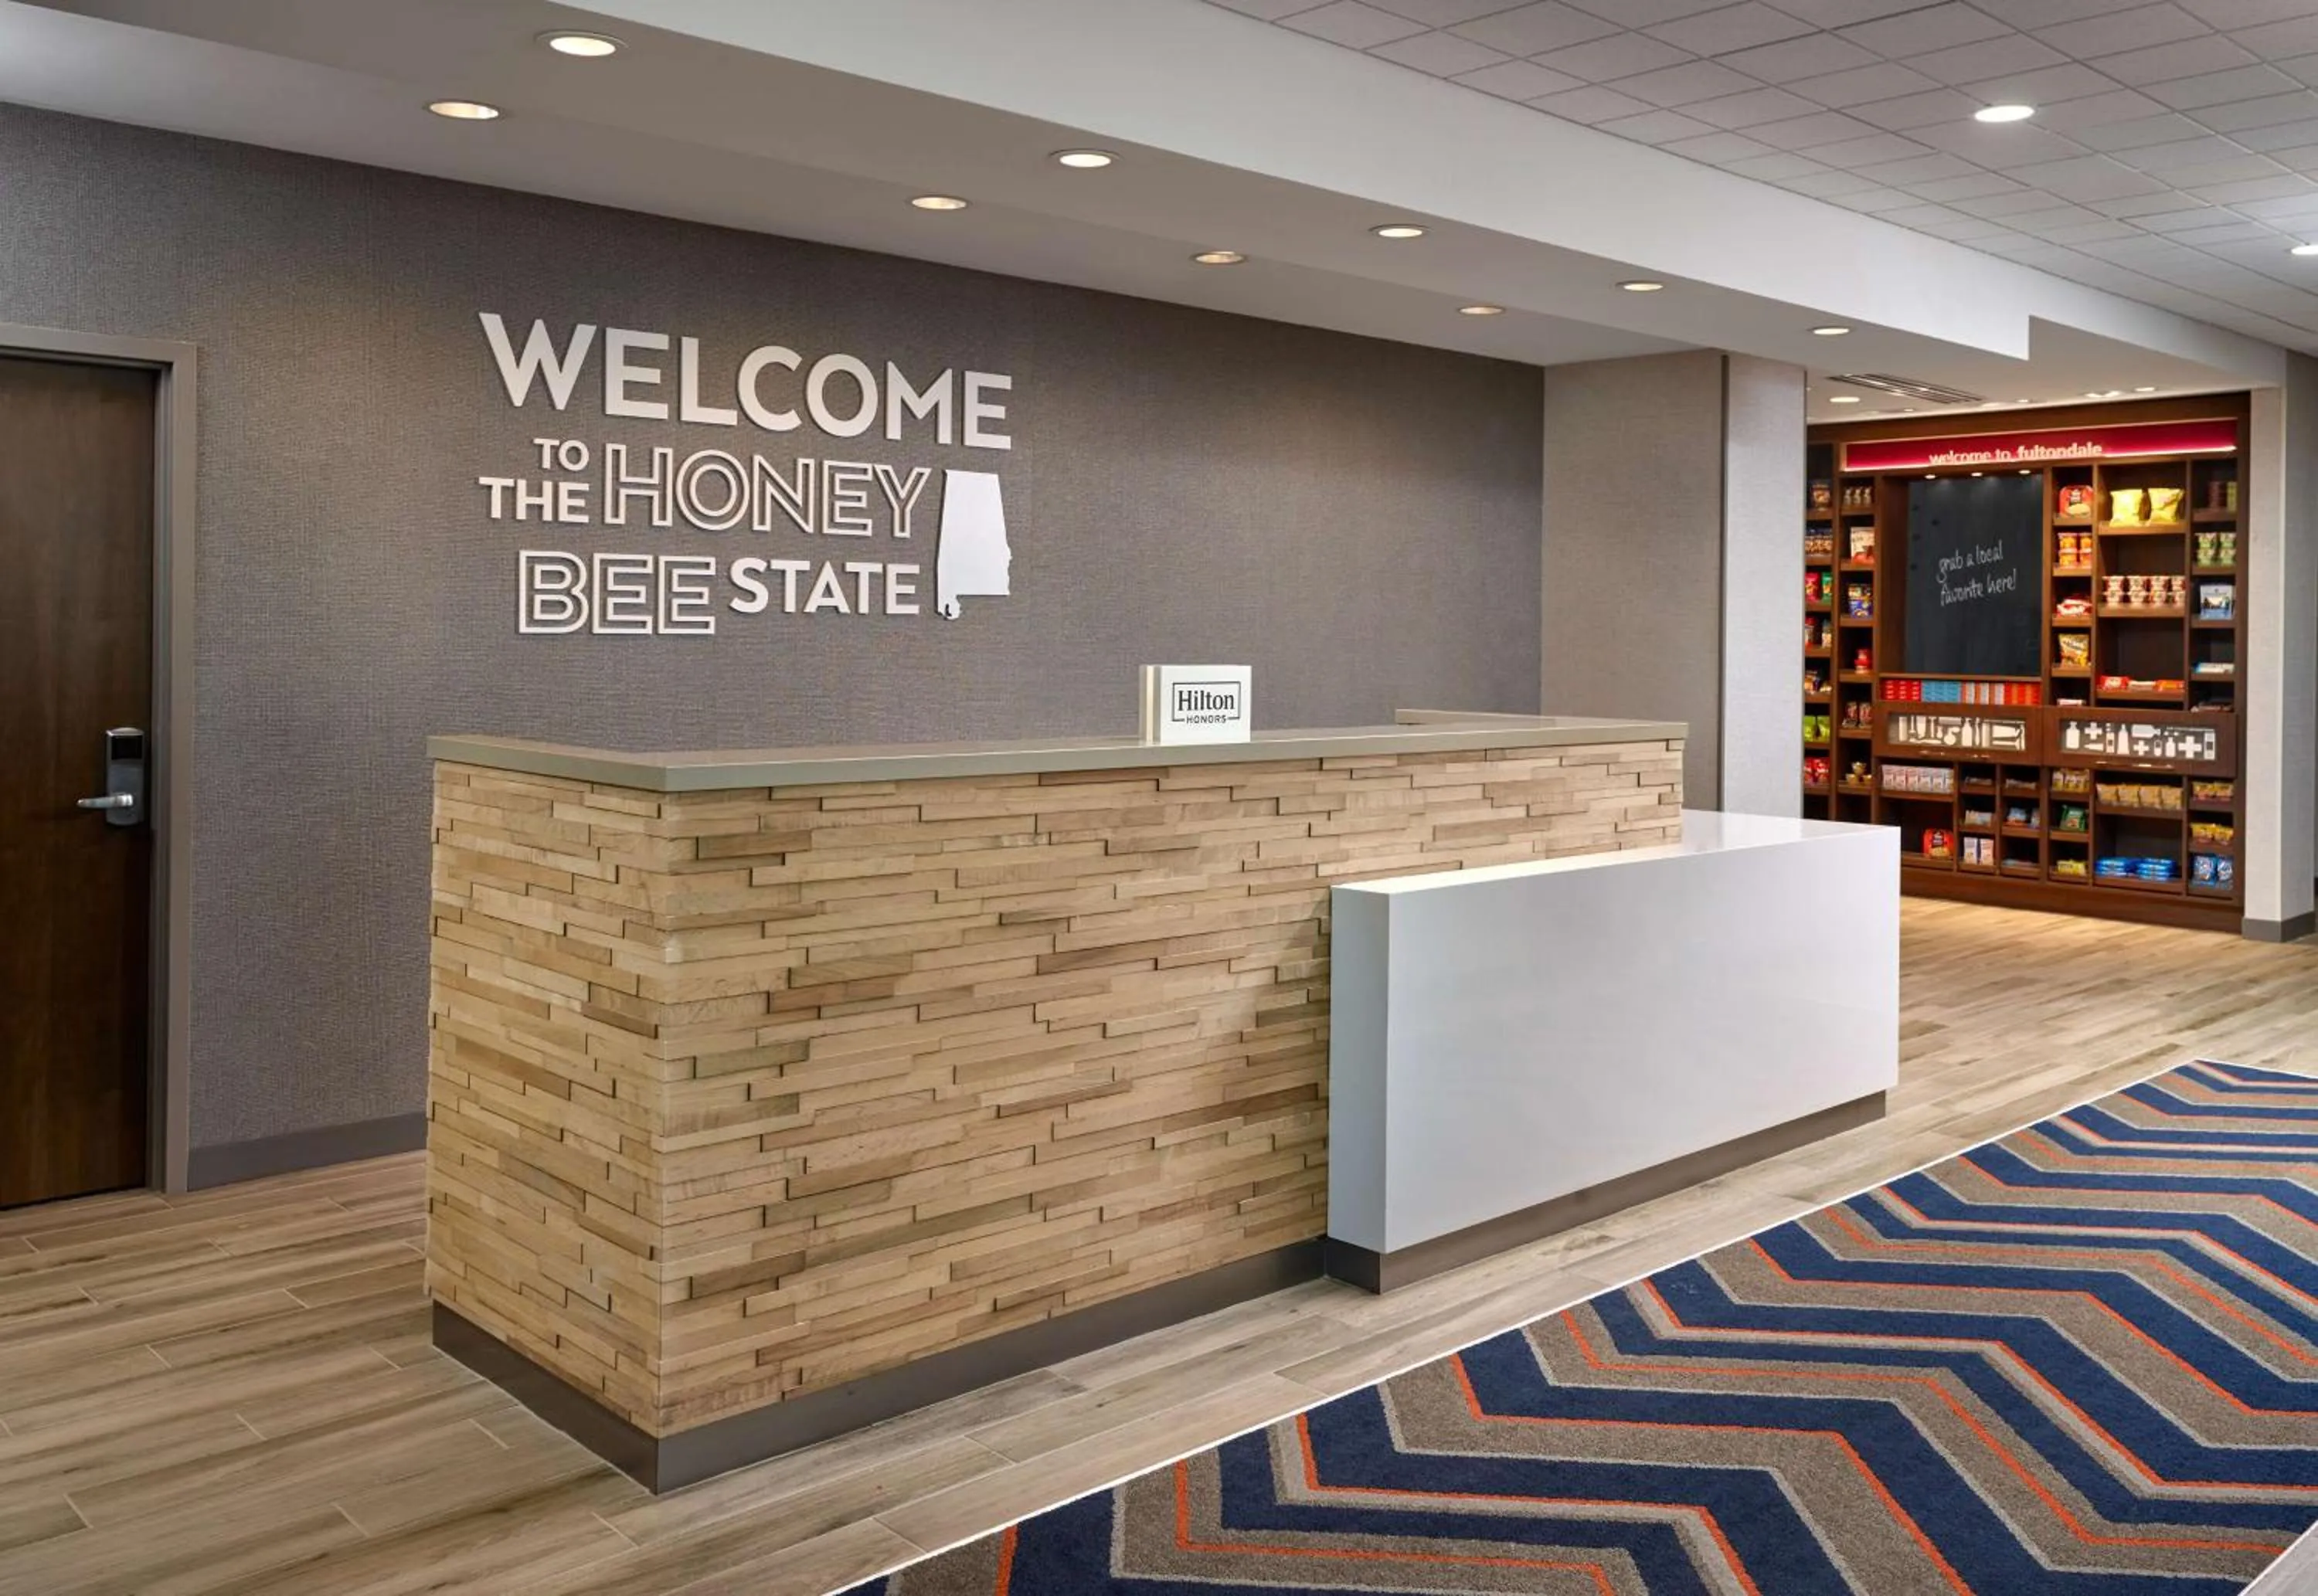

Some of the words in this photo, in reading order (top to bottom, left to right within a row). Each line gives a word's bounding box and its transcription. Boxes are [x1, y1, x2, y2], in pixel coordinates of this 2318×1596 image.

[478, 312, 1011, 450] WELCOME
[533, 438, 590, 470] TO
[1929, 450, 1991, 464] welcome
[1995, 449, 2010, 462] to
[2017, 442, 2102, 461] fultondale
[478, 477, 590, 523] THE
[604, 443, 931, 538] HONEY
[1936, 548, 1963, 584] grab
[1966, 553, 1975, 567] a
[1976, 539, 2004, 565] local
[518, 550, 715, 634] BEE
[729, 557, 921, 614] STATE
[1940, 578, 1984, 606] favorite
[1987, 569, 2017, 594] here!
[1178, 690, 1235, 711] Hilton
[1186, 715, 1227, 724] HONORS
